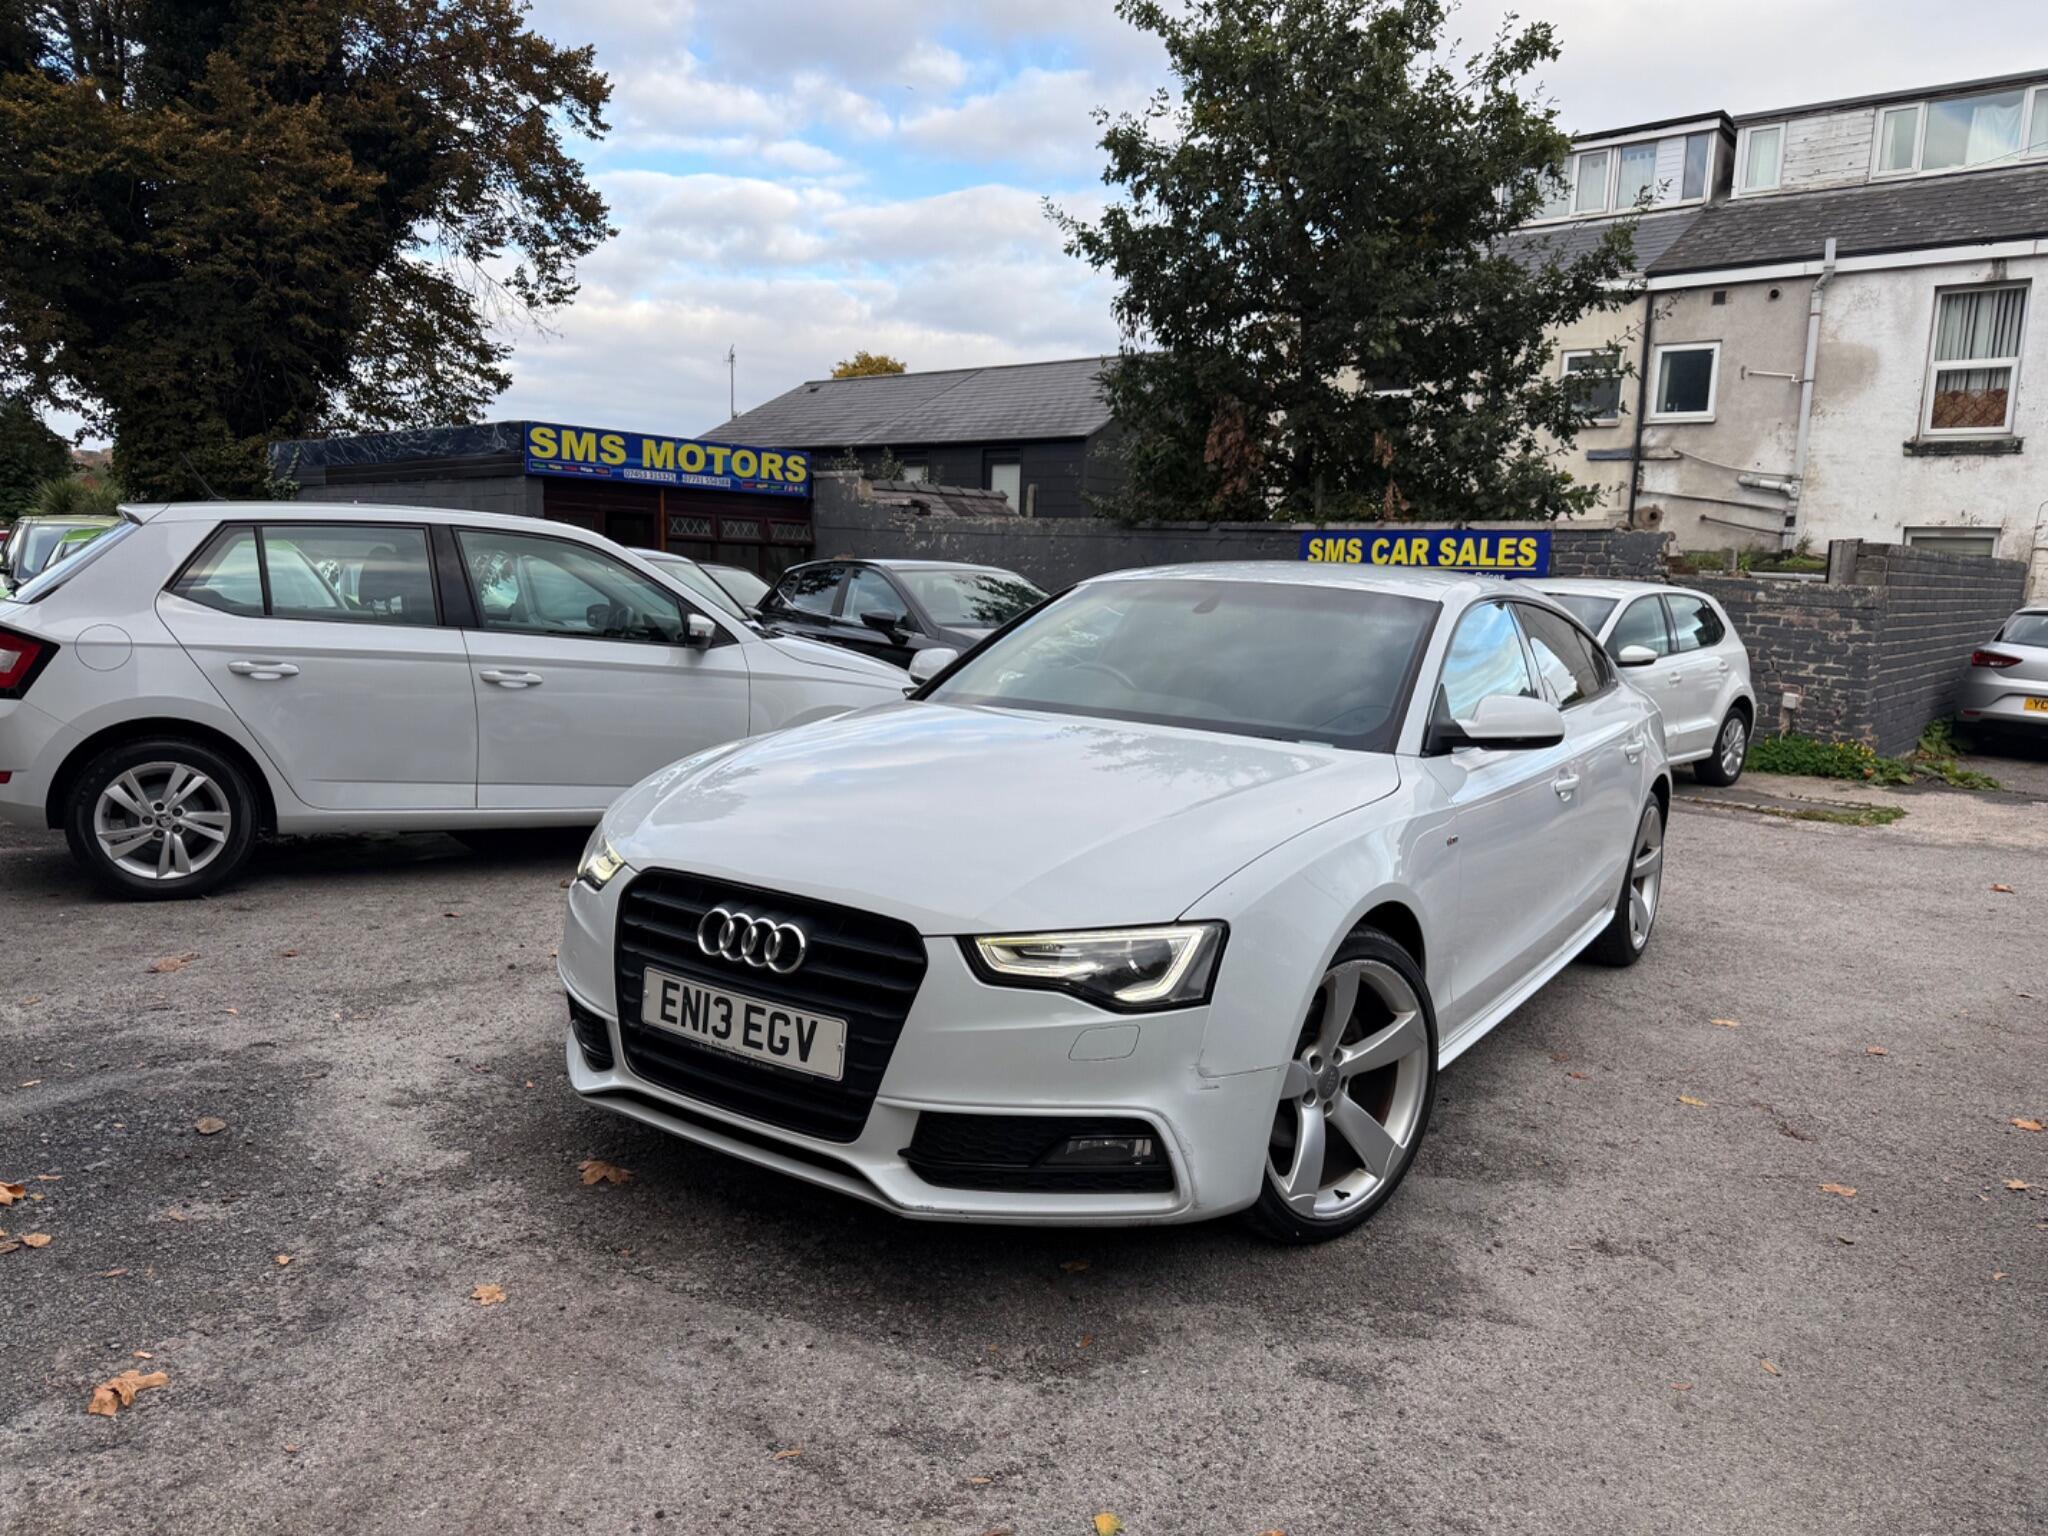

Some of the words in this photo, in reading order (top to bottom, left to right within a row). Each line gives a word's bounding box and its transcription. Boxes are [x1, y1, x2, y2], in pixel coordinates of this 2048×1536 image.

[529, 426, 627, 465] SMS
[642, 438, 807, 483] MOTORS
[1307, 538, 1362, 564] SMS
[1371, 538, 1430, 566] CAR
[1438, 538, 1537, 567] SALES
[660, 979, 734, 1040] EN13
[742, 1003, 818, 1063] EGV
